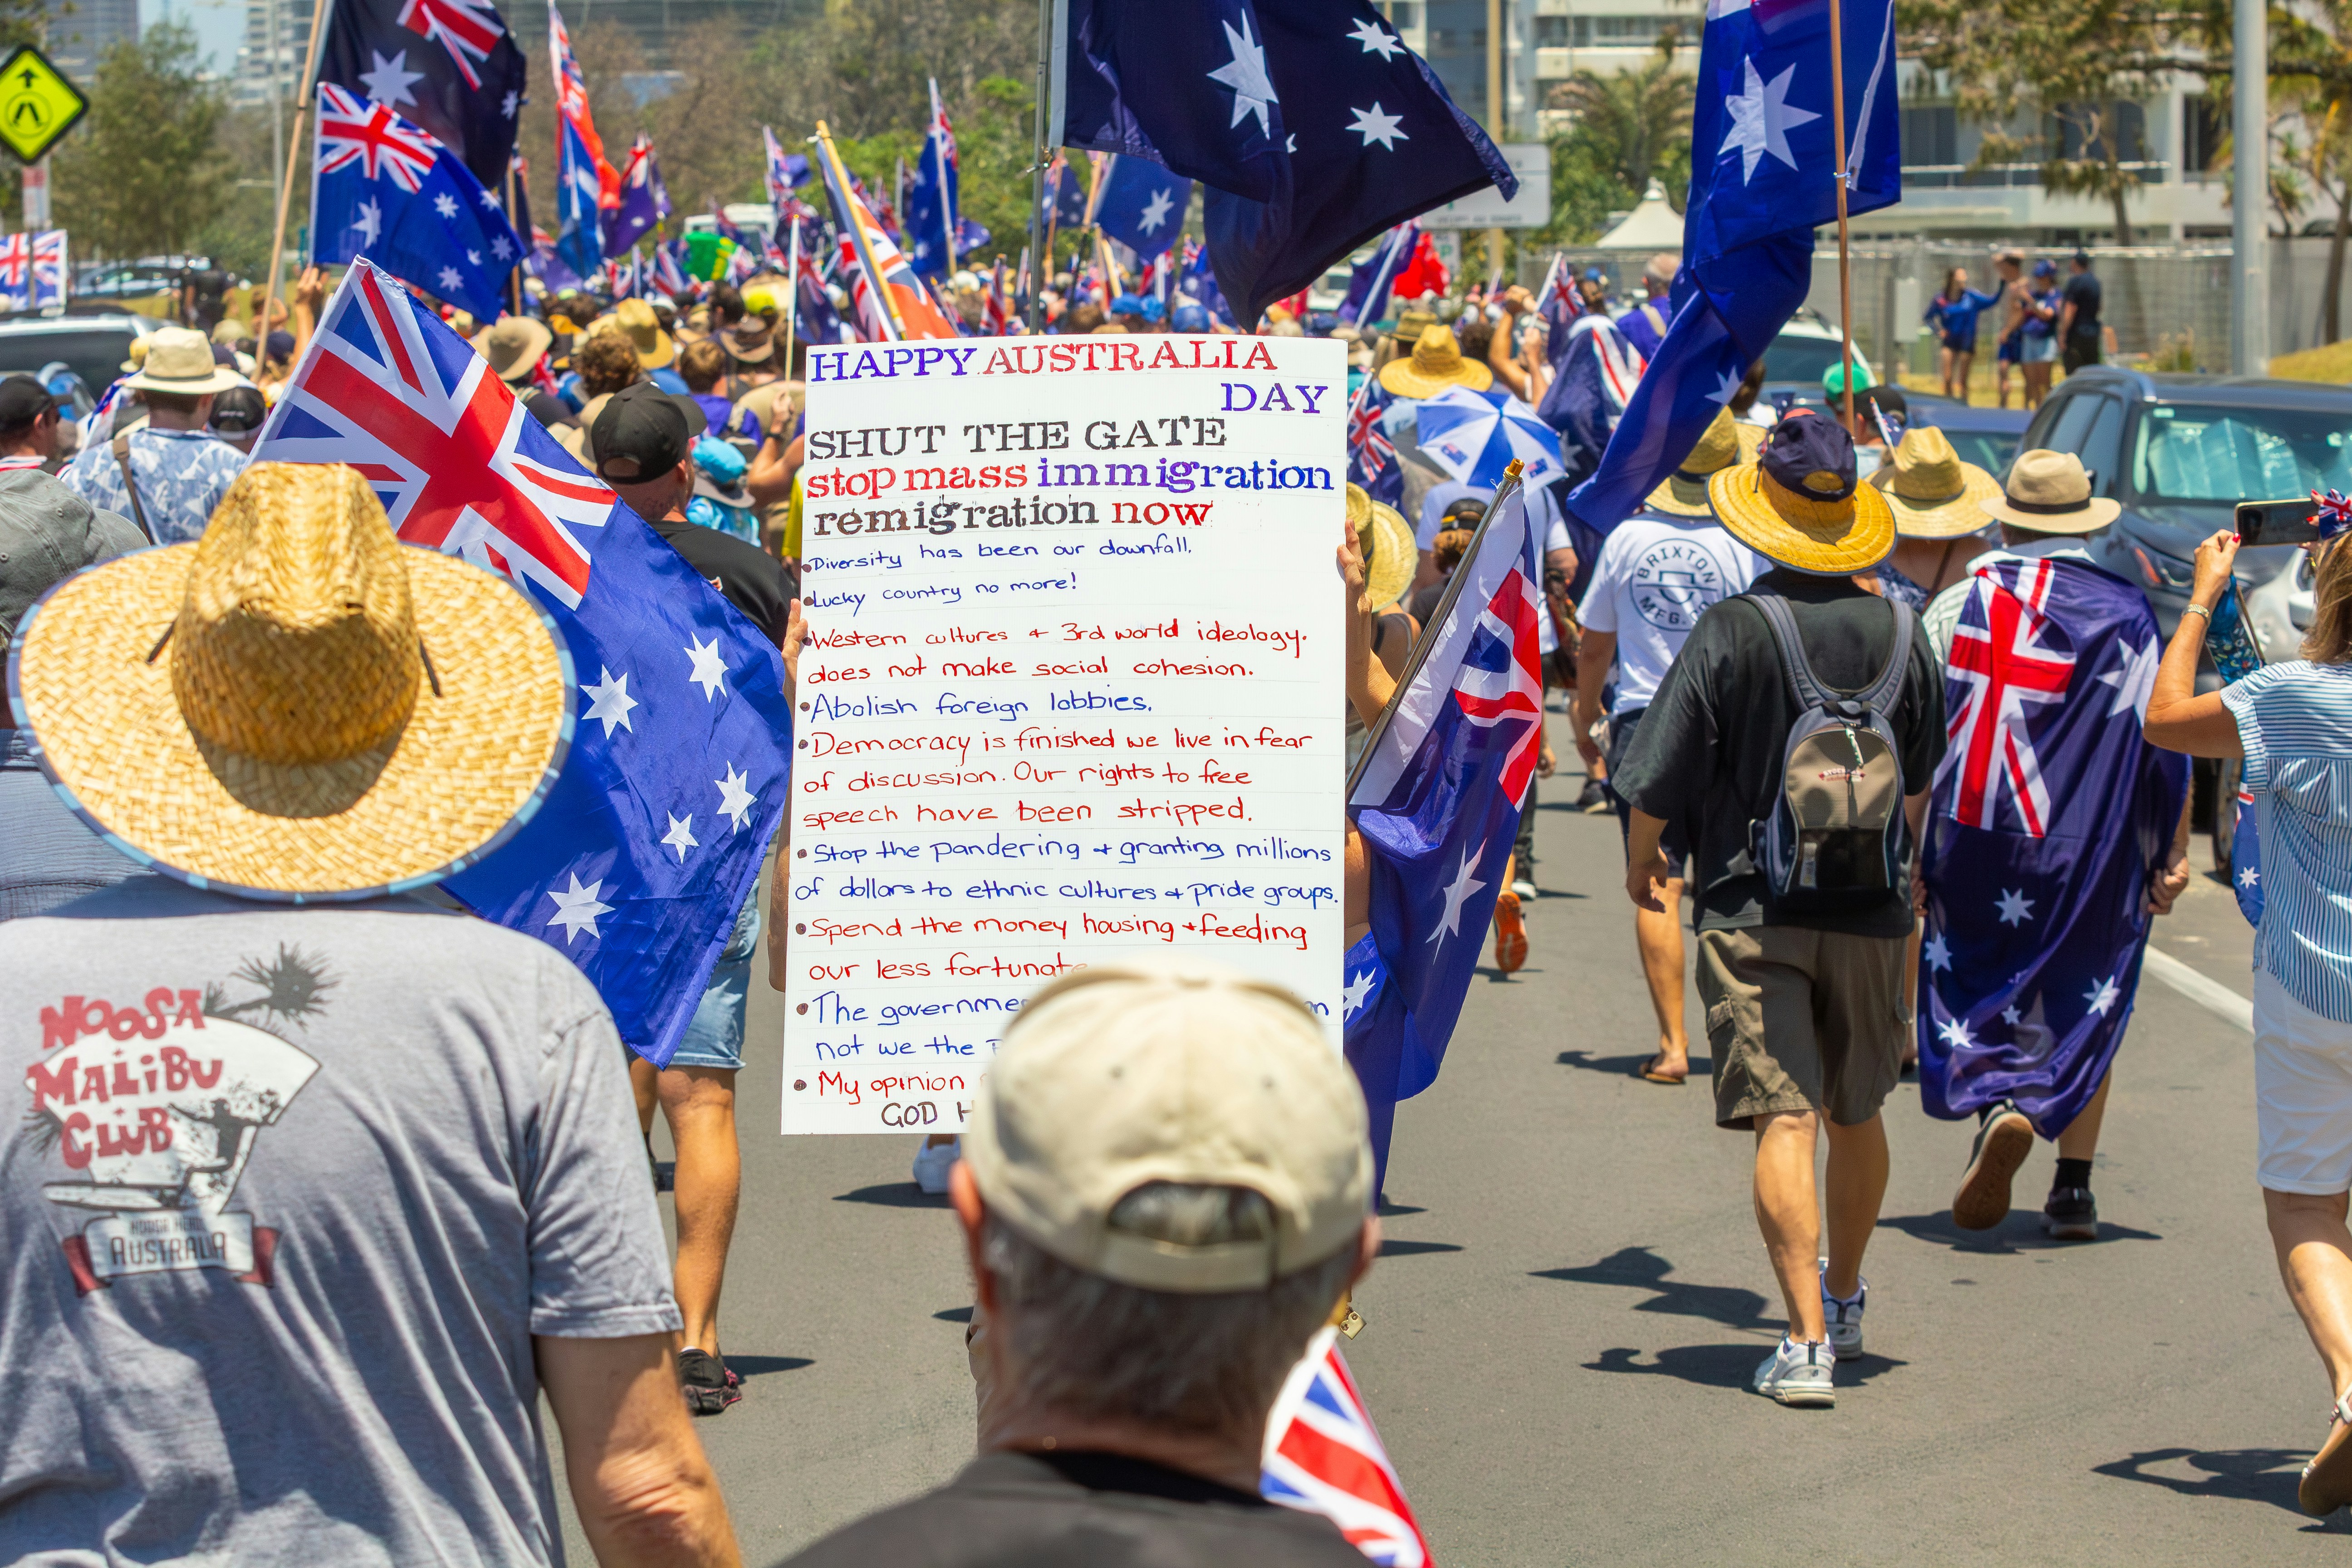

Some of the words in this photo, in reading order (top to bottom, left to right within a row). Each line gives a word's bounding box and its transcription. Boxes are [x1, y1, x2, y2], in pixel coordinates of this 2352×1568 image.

[810, 347, 977, 382] HAPPY
[983, 340, 1278, 375] AUSTRALIA
[1220, 382, 1328, 414] DAY
[809, 425, 946, 460] SHUT
[963, 421, 1069, 453] THE
[1084, 416, 1227, 451] GATE
[807, 467, 896, 500] stop
[902, 464, 1028, 491] mass
[1038, 457, 1334, 494] immigration
[814, 494, 1099, 535] remigration
[1111, 500, 1214, 526] now
[808, 550, 902, 571] Diversity
[920, 544, 963, 559] has
[978, 544, 1039, 557] been
[1054, 545, 1085, 555] our
[1099, 533, 1192, 555] downfall.
[1637, 546, 1716, 584] BRIXTON
[812, 590, 866, 617] Lucky
[882, 585, 962, 604] country
[975, 584, 999, 593] no
[1010, 572, 1076, 591] more!
[811, 628, 906, 650] Western
[926, 626, 1008, 644] cultures
[1061, 622, 1106, 641] 3rd
[1115, 618, 1179, 640] world
[1197, 620, 1307, 657] ideology.
[808, 665, 871, 684] does
[888, 653, 927, 677] not
[942, 656, 1017, 677] make
[1031, 656, 1108, 676] social
[1133, 655, 1254, 676] cohesion.
[811, 693, 917, 723] Abolish
[936, 692, 1029, 721] foreign
[1050, 683, 1152, 711] lobbies.
[811, 732, 970, 767] Democracy
[982, 731, 1006, 752] is
[1013, 726, 1115, 751] finished
[1127, 736, 1159, 748] we
[1174, 727, 1212, 748] live
[1224, 726, 1250, 748] in
[1254, 726, 1313, 749] fear
[804, 771, 835, 793] of
[848, 764, 1007, 792] discussion.
[1014, 761, 1067, 783] Our
[1078, 763, 1155, 786] rights
[1162, 762, 1189, 784] to
[1198, 758, 1252, 784] free
[803, 805, 898, 831] speech
[917, 804, 999, 822] have
[1017, 800, 1091, 823] been
[1117, 796, 1252, 827] stripped.
[814, 844, 867, 864] Stop
[876, 840, 920, 859] the
[929, 833, 1079, 863] pandering
[1118, 836, 1225, 864] granting
[1236, 836, 1331, 862] millions
[795, 877, 824, 900] of
[839, 876, 915, 899] dollars
[921, 881, 952, 897] to
[966, 880, 1049, 900] ethnic
[1059, 880, 1156, 900] cultures
[1187, 880, 1254, 907] pride
[1264, 886, 1338, 910] groups.
[808, 918, 902, 946] Spend
[911, 916, 962, 936] the
[973, 918, 1067, 940] money
[1083, 912, 1174, 942] housing
[1199, 913, 1308, 951] feeding
[809, 964, 860, 980] our
[877, 959, 931, 980] less
[39, 987, 207, 1049] NOOSA
[812, 990, 869, 1024] The
[816, 1034, 864, 1061] not
[879, 1042, 916, 1055] we
[924, 1034, 975, 1055] the
[818, 1070, 861, 1105] My
[870, 1075, 965, 1098] opinion
[881, 1101, 938, 1128] GOD
